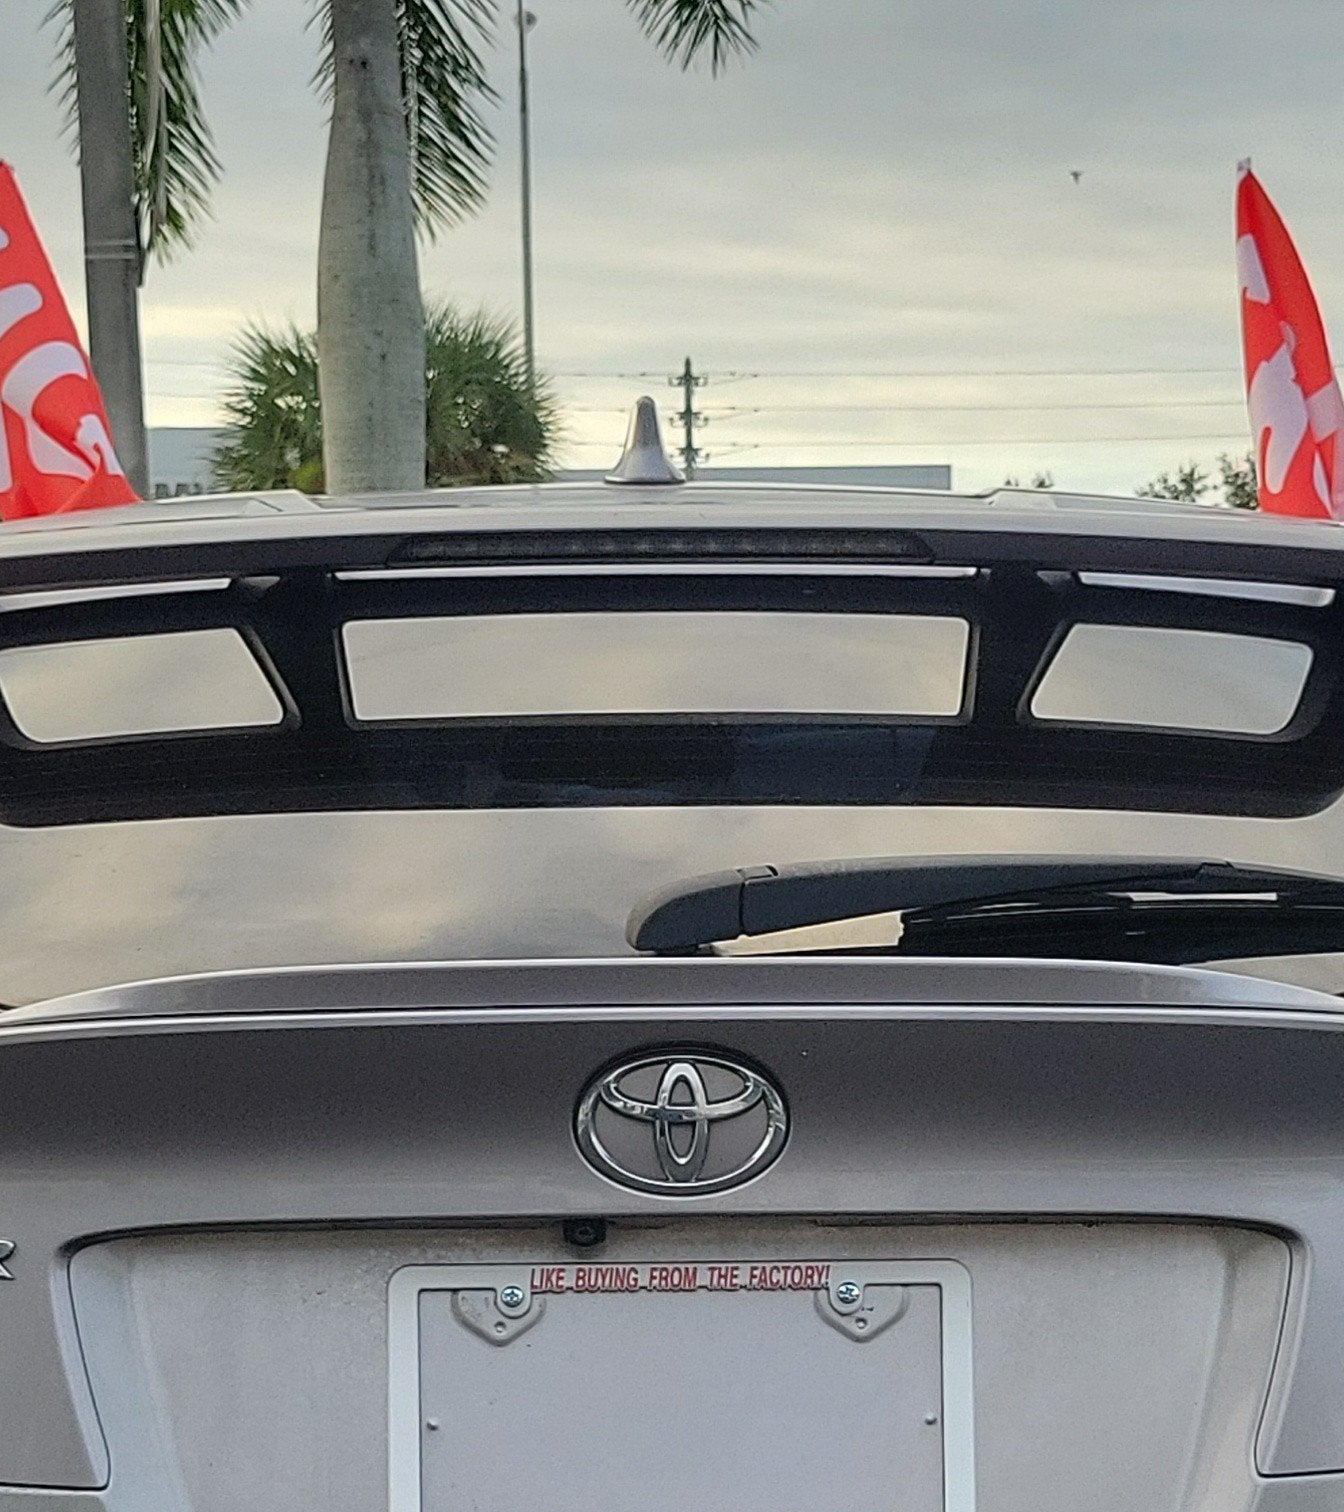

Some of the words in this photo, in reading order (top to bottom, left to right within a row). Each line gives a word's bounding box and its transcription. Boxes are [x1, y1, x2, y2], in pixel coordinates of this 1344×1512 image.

[530, 1267, 566, 1290] LIKE
[574, 1267, 639, 1290] BUYING
[648, 1266, 698, 1289] FROM
[708, 1265, 740, 1288] THE
[749, 1264, 831, 1287] FACTORY!
